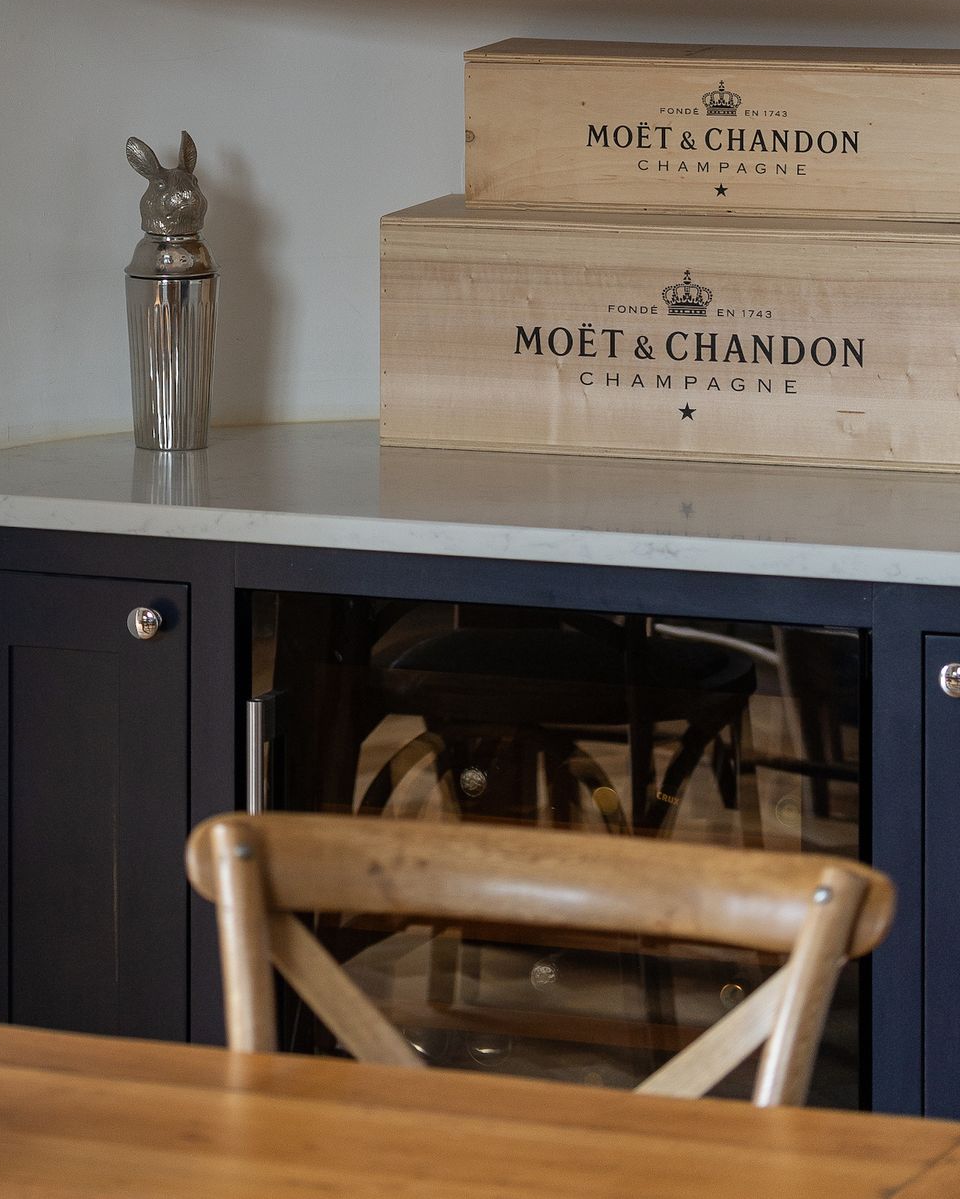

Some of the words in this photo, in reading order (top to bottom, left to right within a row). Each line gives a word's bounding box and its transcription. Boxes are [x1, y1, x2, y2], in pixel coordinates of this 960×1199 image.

[659, 107, 700, 115] FONDÉ
[744, 109, 759, 117] EN
[763, 110, 788, 118] 1743
[586, 121, 673, 150] MOËT
[680, 131, 698, 151] &
[704, 127, 860, 154] CHANDON
[637, 159, 807, 176] CHAMPAGNE
[607, 304, 659, 315] FONDÉ
[716, 308, 735, 318] EN
[741, 309, 773, 319] 1743
[513, 322, 625, 359] MOËT
[633, 335, 656, 360] &
[665, 331, 866, 368] CHANDON
[579, 371, 798, 395] CHAMPAGNE
